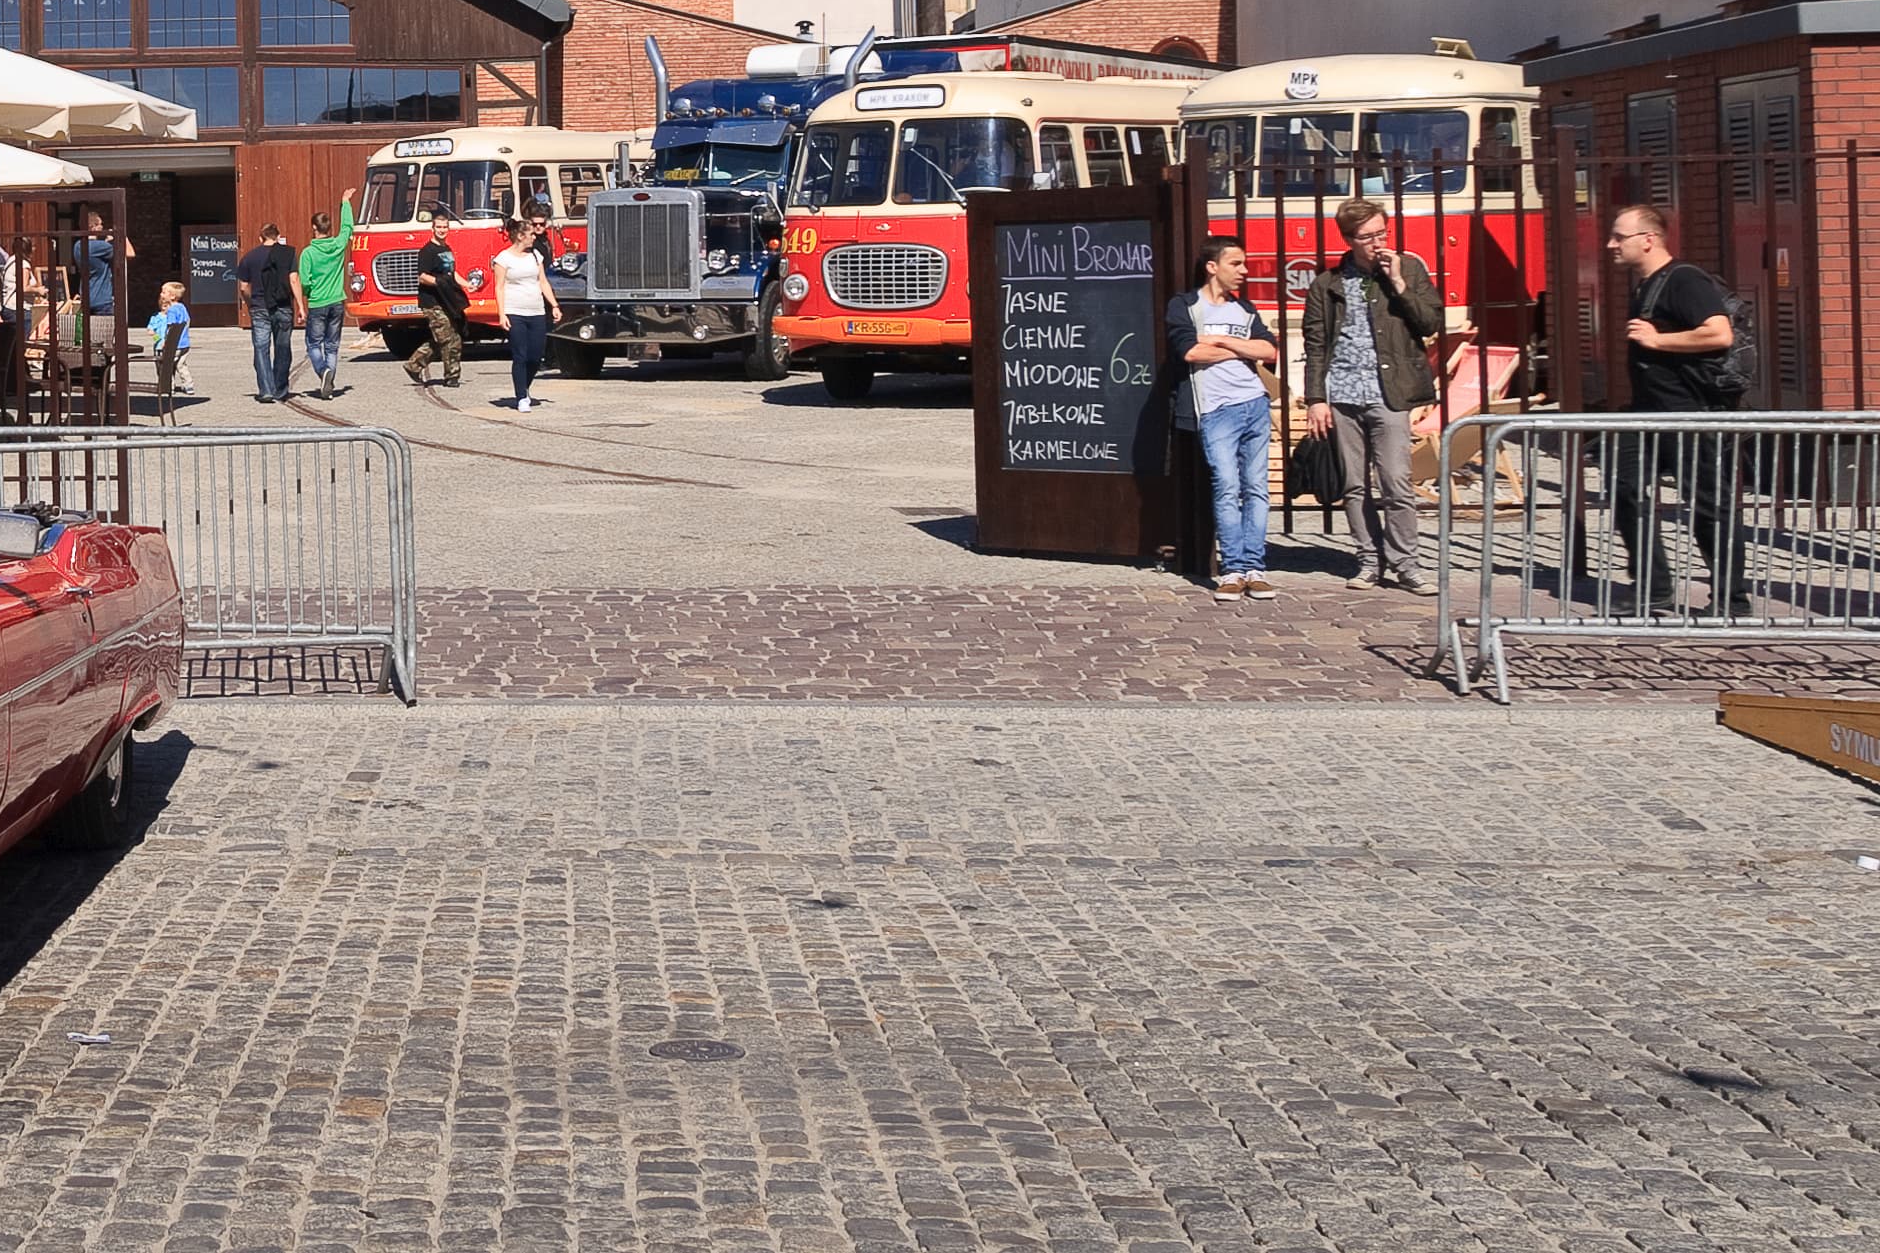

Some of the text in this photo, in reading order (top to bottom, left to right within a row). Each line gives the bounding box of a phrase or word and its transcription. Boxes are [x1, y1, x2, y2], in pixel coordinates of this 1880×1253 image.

[1290, 72, 1319, 85] MPK
[1001, 284, 1069, 324] JASNE
[1002, 324, 1086, 350] CIEMNE
[1110, 333, 1135, 384] 6
